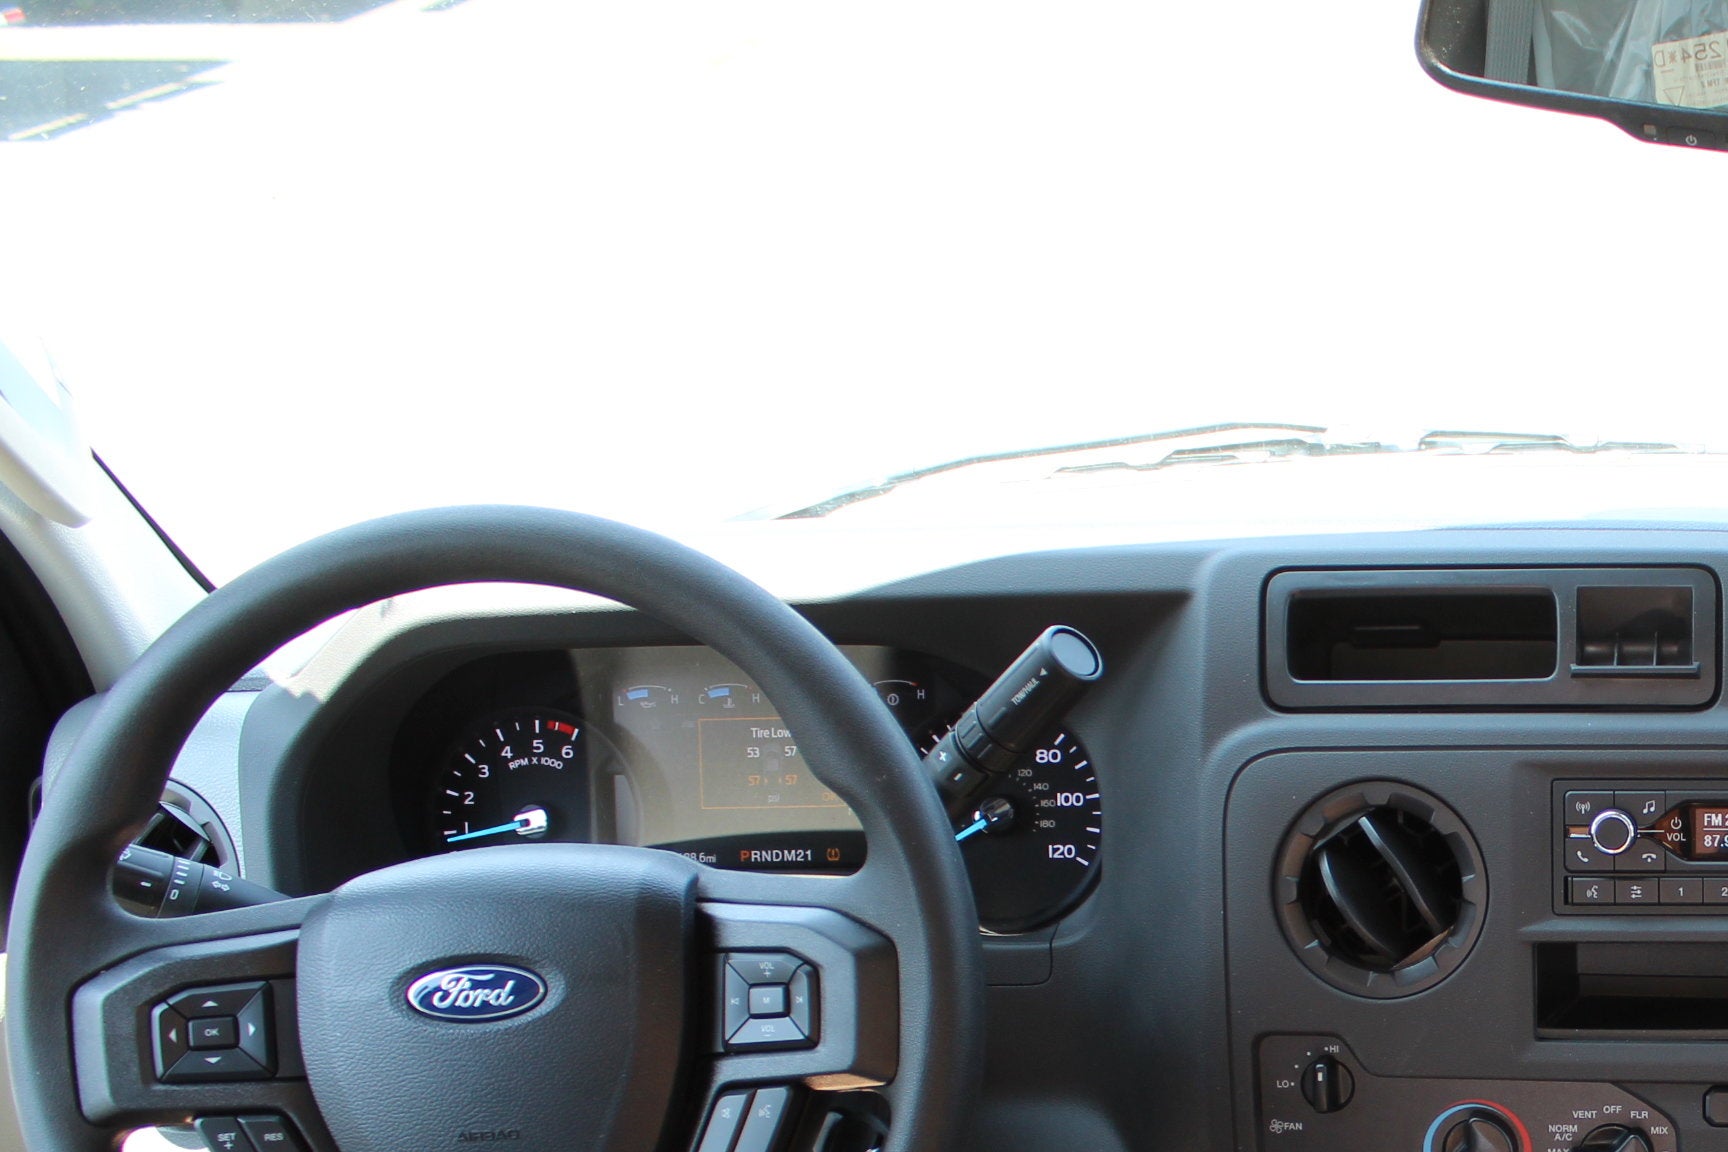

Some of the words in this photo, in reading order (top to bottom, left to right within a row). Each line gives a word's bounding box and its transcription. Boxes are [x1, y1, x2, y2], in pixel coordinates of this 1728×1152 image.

[1011, 677, 1040, 706] TOW/HAUL
[750, 728, 769, 738] Tire
[532, 740, 544, 753] 5
[784, 746, 797, 757] 57
[501, 746, 513, 759] 4
[561, 745, 573, 759] 6
[747, 747, 760, 758] 53
[1035, 749, 1061, 763] 80
[508, 757, 529, 770] RPM
[540, 757, 563, 769] 1000
[478, 764, 489, 777] 3
[1017, 769, 1032, 777] 120
[1033, 782, 1049, 791] 140
[464, 791, 475, 804] 2
[1056, 793, 1084, 806] 100
[1039, 820, 1055, 828] 180
[1704, 813, 1723, 827] FM
[1666, 832, 1686, 842] VOL
[1048, 844, 1075, 858] 120
[1721, 887, 1728, 897] 2
[432, 973, 515, 1008] Ford
[204, 1028, 219, 1036] OK
[1329, 1045, 1339, 1054] HI
[1276, 1080, 1289, 1088] LO
[1572, 1110, 1597, 1119] VENT
[1603, 1105, 1622, 1114] OFF
[1630, 1110, 1648, 1119] FLR
[1284, 1122, 1303, 1131] FAN
[1548, 1124, 1578, 1133] NORM
[1650, 1126, 1668, 1135] MIX
[217, 1132, 236, 1142] SET
[264, 1132, 284, 1141] RES
[456, 1129, 520, 1143] AIRBAG
[1554, 1133, 1573, 1142] A/C
